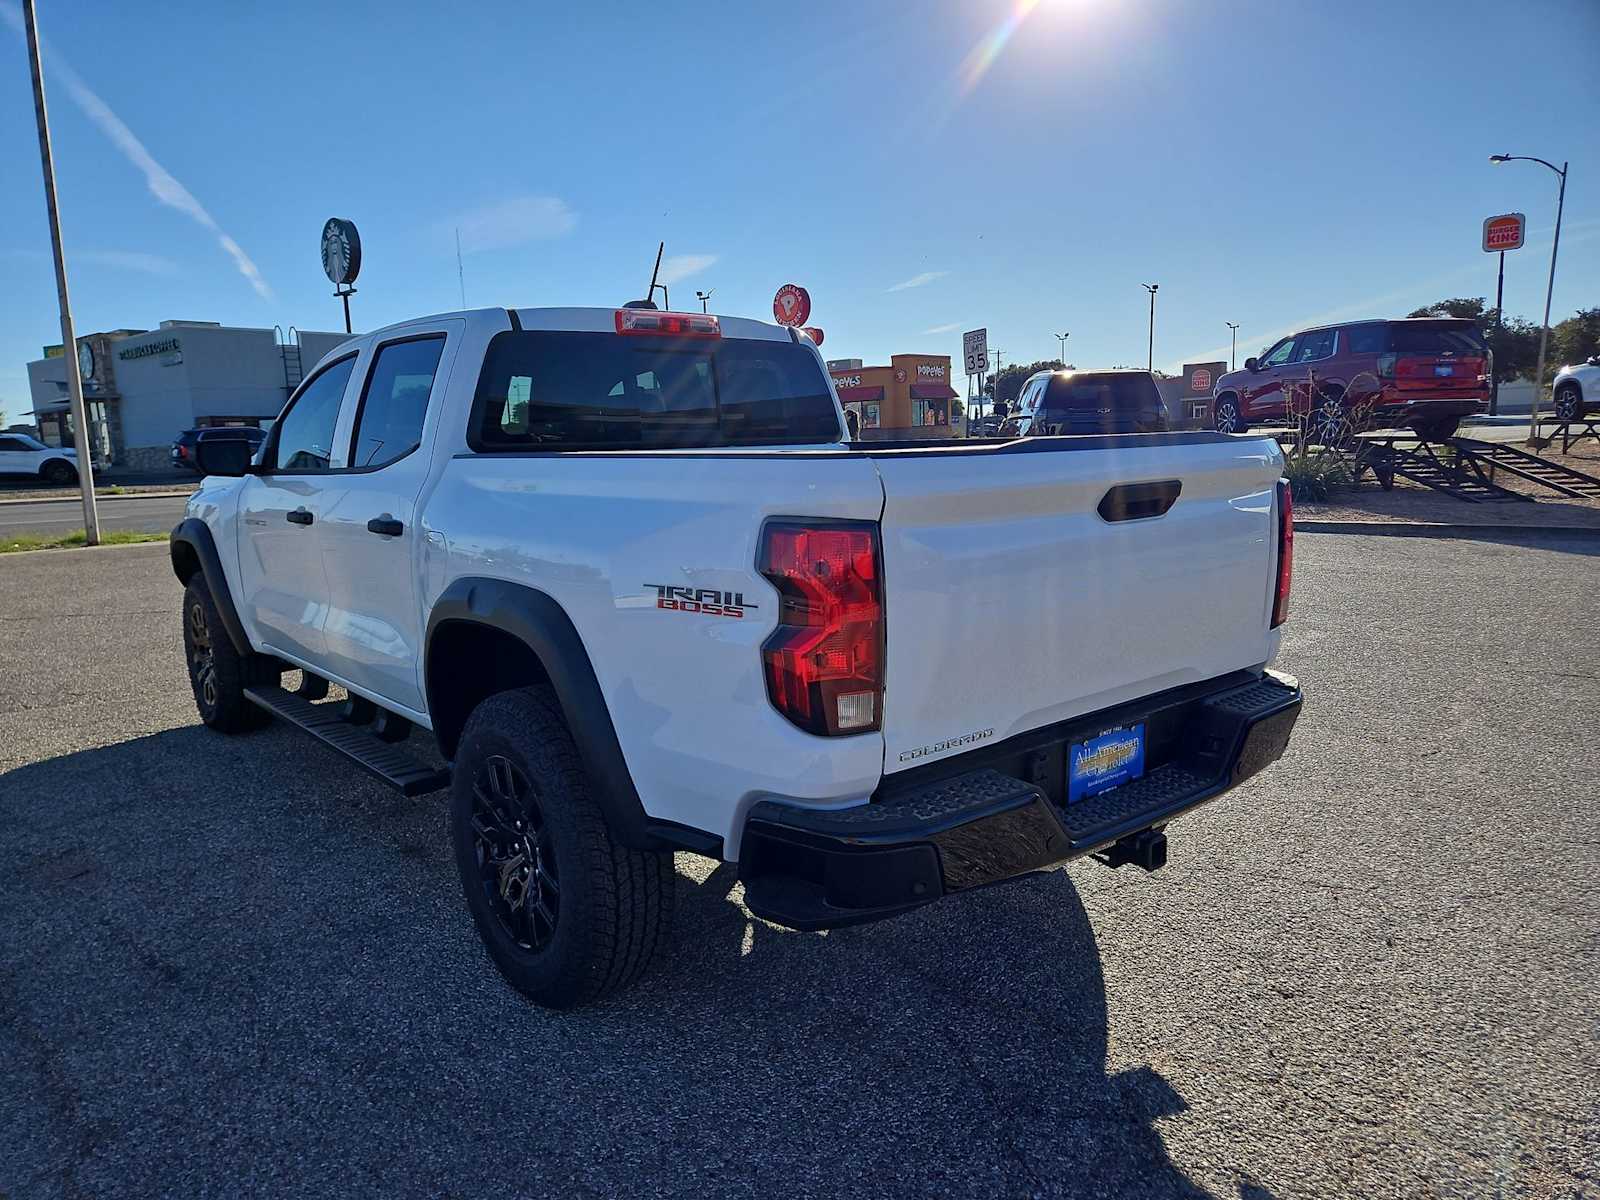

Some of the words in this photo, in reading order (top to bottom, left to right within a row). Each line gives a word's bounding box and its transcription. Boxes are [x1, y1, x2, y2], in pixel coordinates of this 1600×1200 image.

[1487, 224, 1520, 235] BURGER
[1487, 232, 1519, 244] KING
[965, 333, 984, 344] SPEED
[917, 365, 945, 377] POPEYES
[967, 353, 986, 371] 35
[643, 583, 758, 609] TRAIL
[657, 598, 744, 618] BOSS
[899, 727, 994, 762] COLORADO
[1076, 747, 1092, 766] All
[1096, 737, 1140, 757] American
